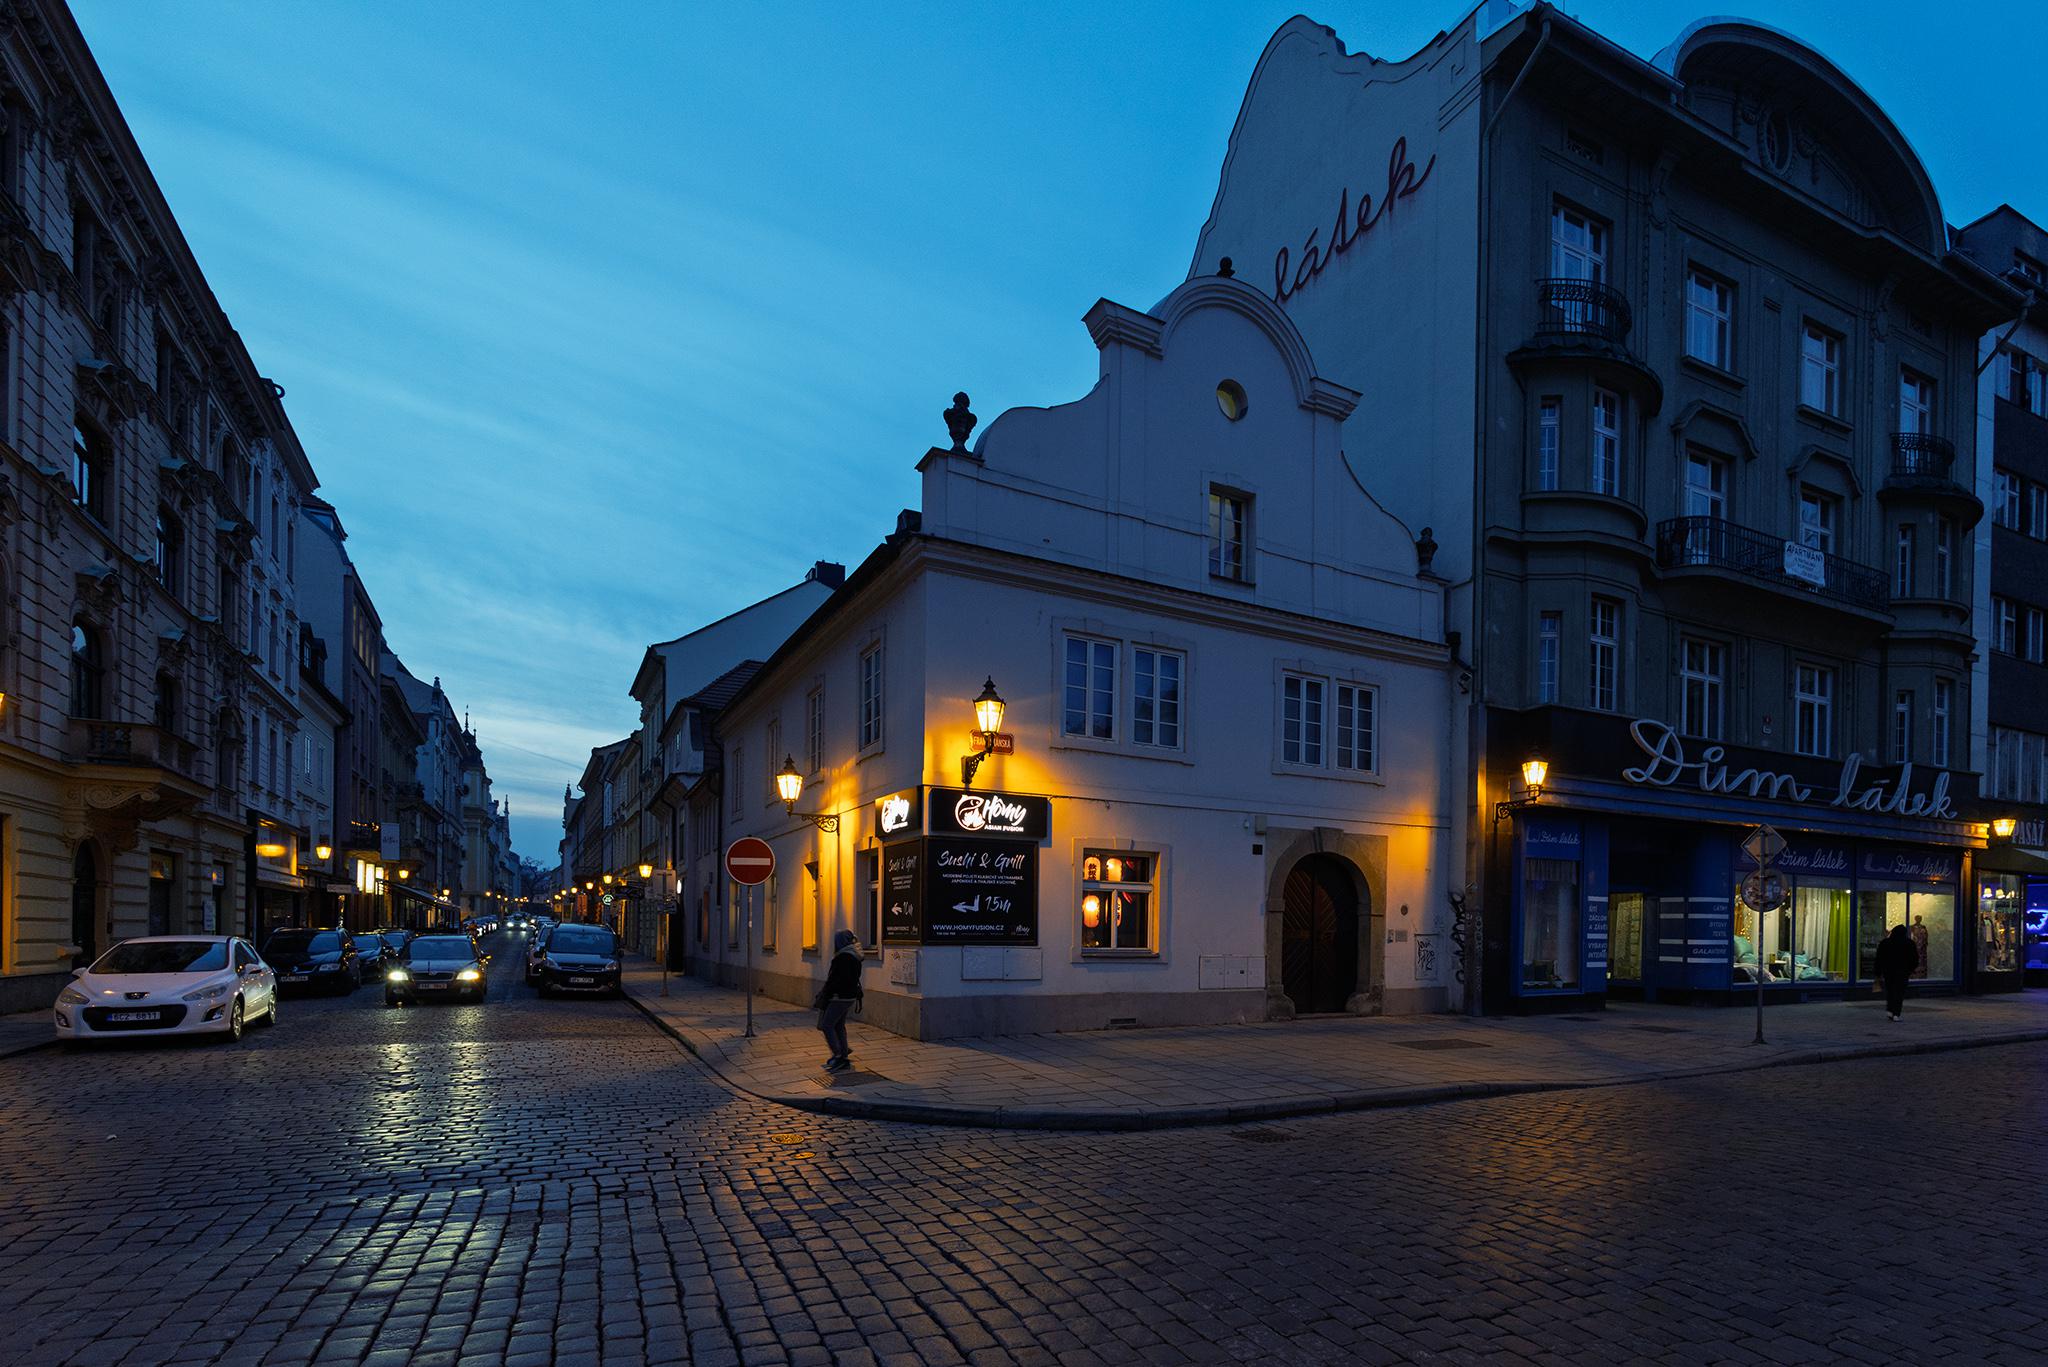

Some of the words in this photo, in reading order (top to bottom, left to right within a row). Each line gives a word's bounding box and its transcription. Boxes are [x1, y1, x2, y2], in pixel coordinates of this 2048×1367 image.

[1622, 718, 1813, 802] Dům
[937, 850, 977, 869] Sushi
[979, 852, 992, 868] &
[994, 853, 1026, 873] Grill
